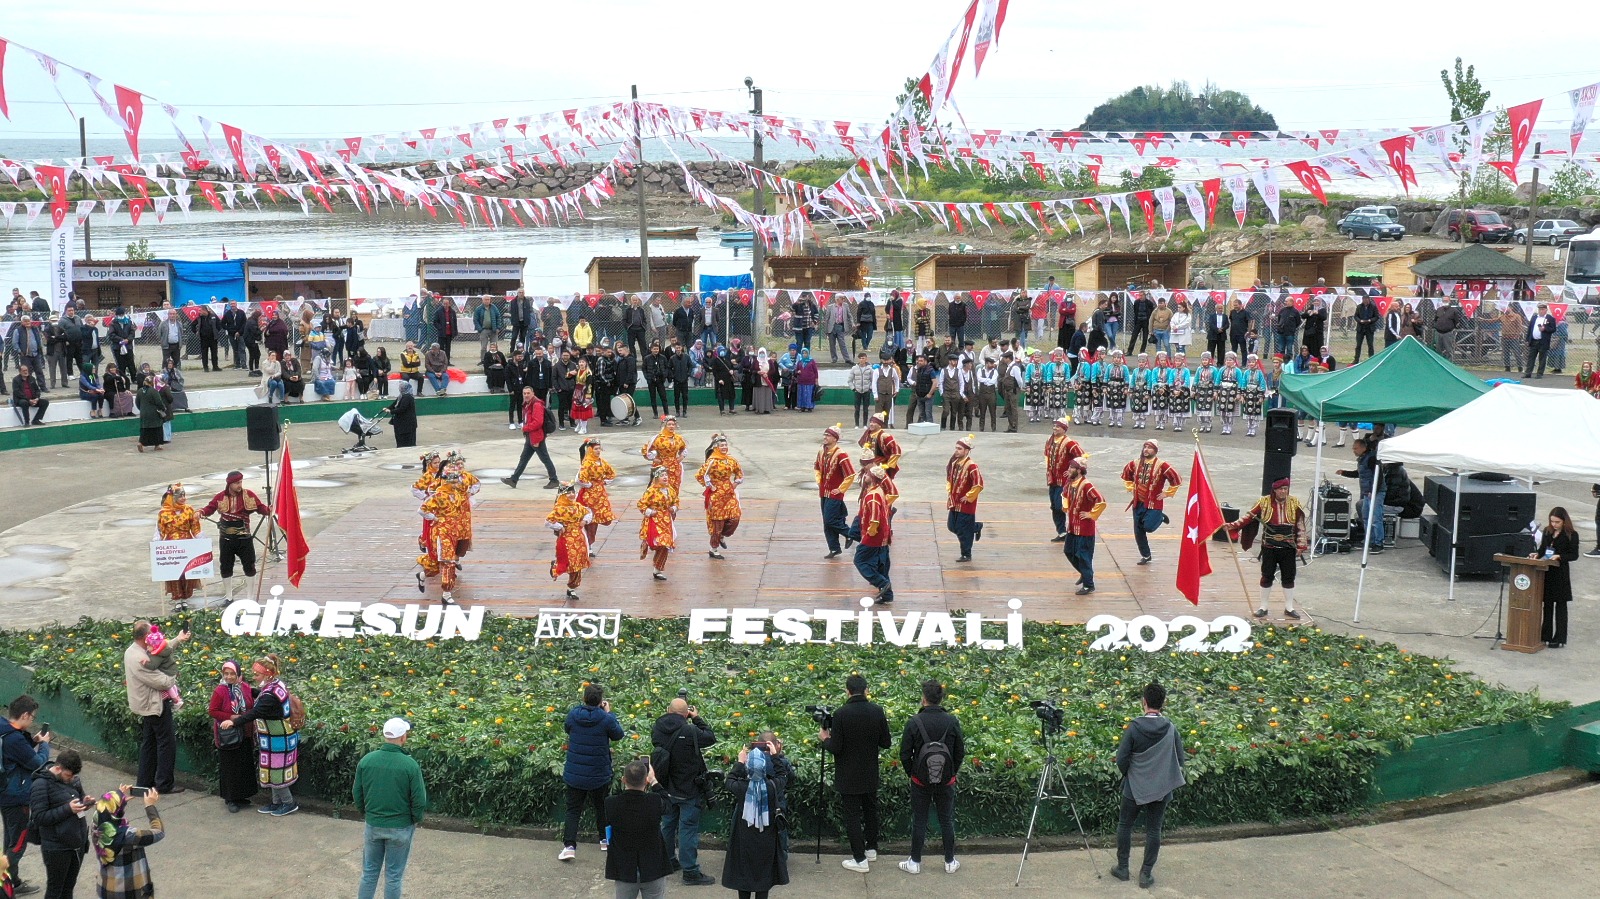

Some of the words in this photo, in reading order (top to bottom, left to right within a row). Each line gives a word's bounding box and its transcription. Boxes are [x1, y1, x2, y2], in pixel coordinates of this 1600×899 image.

[57, 232, 68, 299] toprakanadan
[88, 268, 165, 279] toprakanadan
[221, 585, 485, 641] GİRESUN
[535, 612, 621, 640] AKSU
[688, 597, 1023, 650] FESTİVALİ
[1086, 614, 1253, 652] 2022
